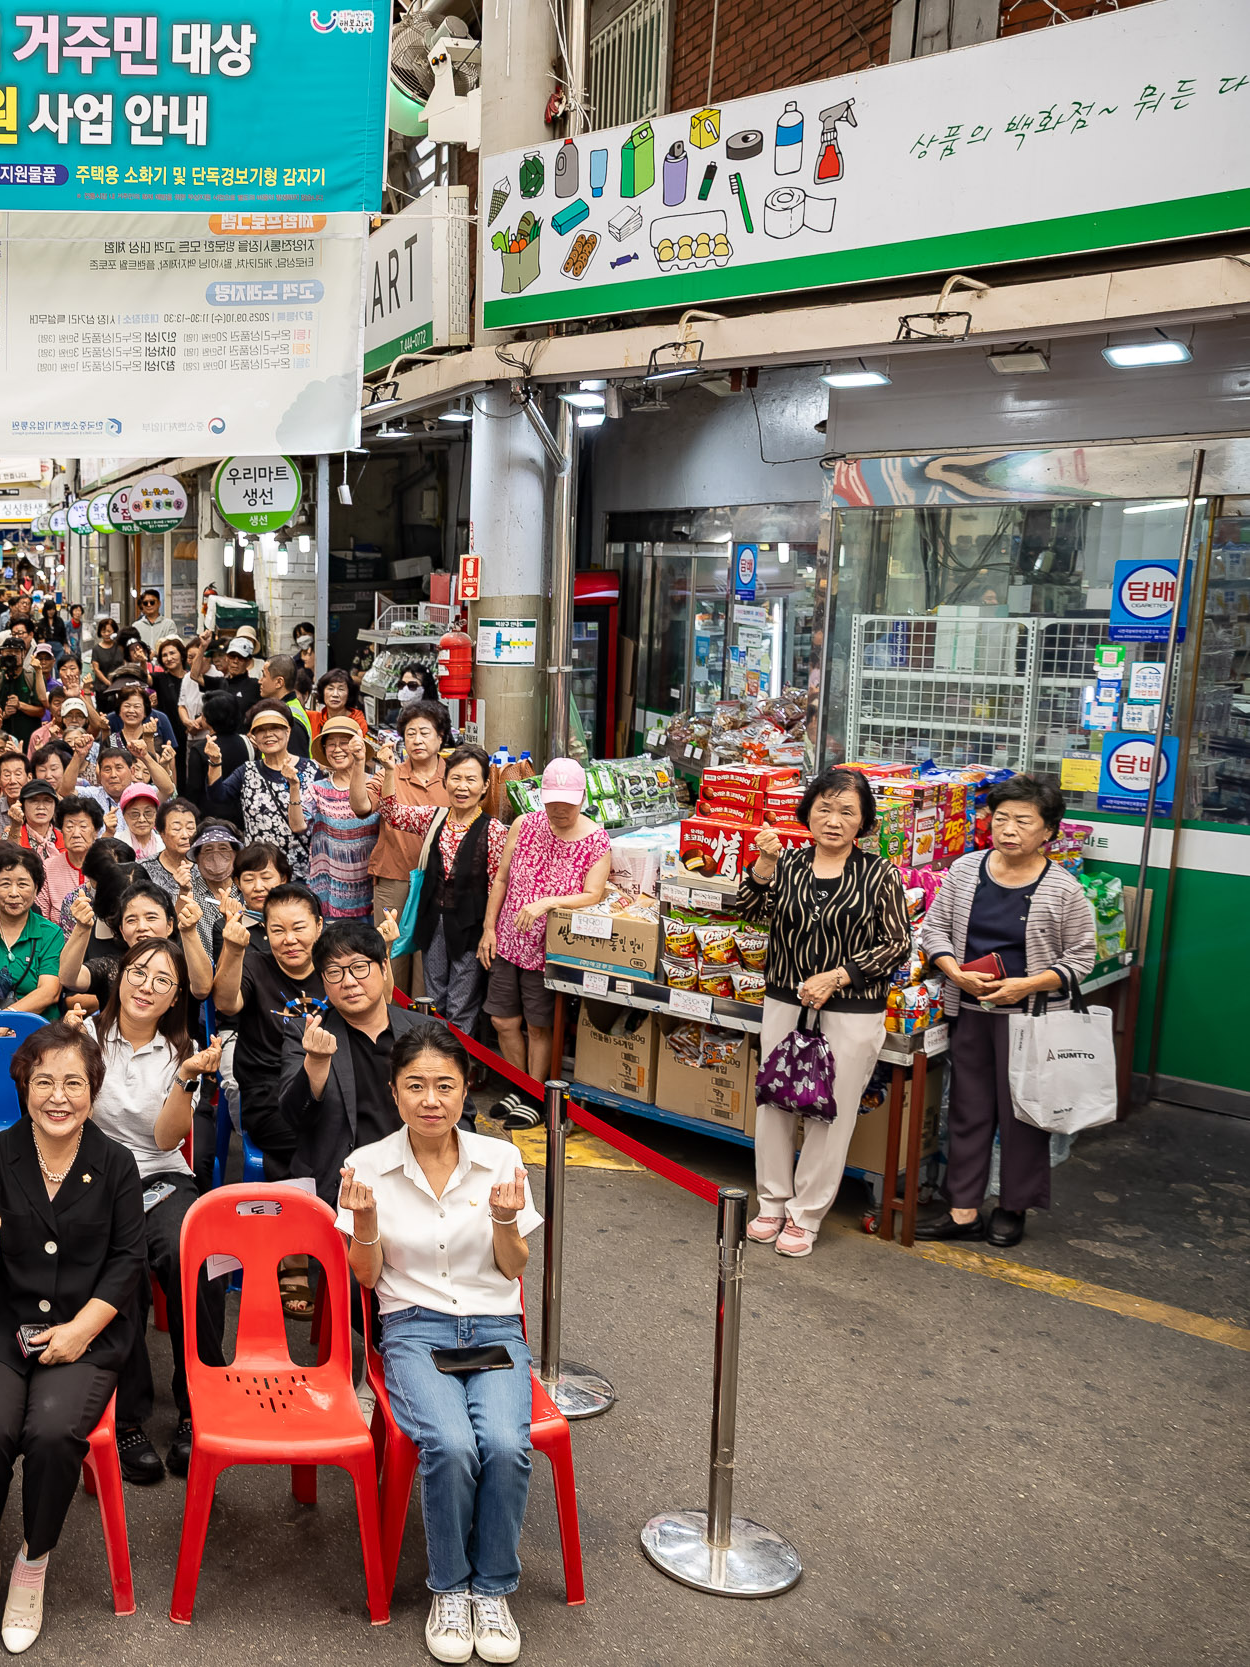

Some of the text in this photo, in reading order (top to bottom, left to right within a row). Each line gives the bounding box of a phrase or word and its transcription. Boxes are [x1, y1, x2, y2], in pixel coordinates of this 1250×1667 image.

[14, 14, 157, 76] 거주민
[172, 23, 258, 77] 대상
[29, 95, 113, 145] 사업
[125, 95, 208, 147] 안내
[910, 124, 993, 160] 상품의
[1134, 79, 1197, 120] 뭐든
[0, 165, 57, 184] 지원물품
[75, 166, 120, 185] 주택용
[124, 167, 168, 186] 소화기
[173, 167, 186, 186] 및
[192, 168, 278, 187] 단독경보기형
[283, 168, 326, 187] 감지기
[365, 233, 417, 327] ART
[226, 465, 290, 486] 우리마트
[242, 488, 274, 507] 생선
[249, 515, 269, 526] 생선
[1127, 581, 1176, 602] 담배
[555, 774, 568, 786] W
[684, 833, 712, 846] 초코파이
[944, 818, 964, 841] ZEC
[613, 1036, 634, 1051] 54개입
